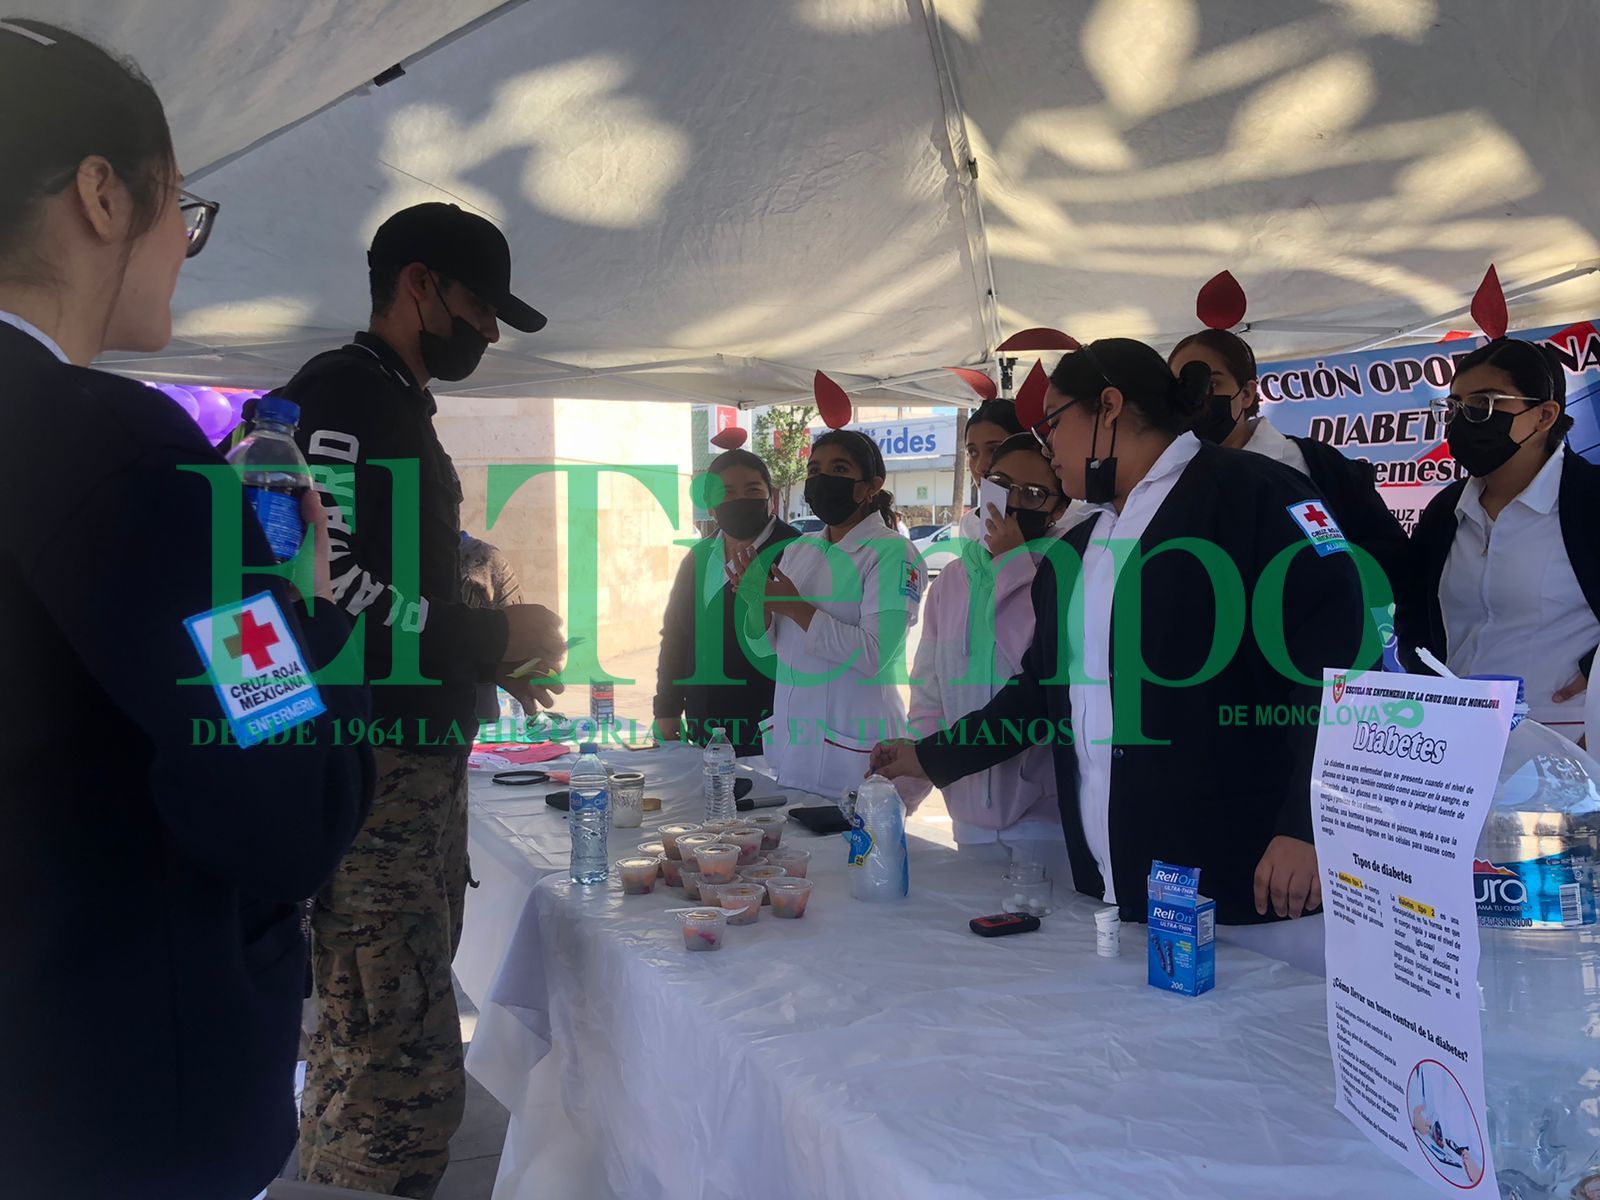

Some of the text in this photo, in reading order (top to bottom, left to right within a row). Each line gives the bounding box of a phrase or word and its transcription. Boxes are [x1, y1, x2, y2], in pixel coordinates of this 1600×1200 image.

[230, 661, 302, 698] CRUZ ROJA
[239, 675, 306, 711] MEXICANA
[1346, 686, 1365, 694] ESCUELA
[1366, 688, 1372, 696] DE
[1406, 691, 1415, 700] DE
[1416, 692, 1424, 701] LA
[1425, 694, 1442, 703] CRUZ
[1458, 697, 1468, 706] DE
[1468, 698, 1499, 709] MONCLOVA
[1353, 720, 1447, 764] Diabetes
[1396, 786, 1410, 794] como
[1425, 779, 1443, 788] cuando
[1445, 782, 1451, 790] el
[1451, 784, 1465, 792] nivel
[1466, 786, 1474, 794] de
[1156, 870, 1196, 887] ReliOn
[1353, 853, 1371, 869] Tipos
[1372, 860, 1380, 872] de
[1382, 863, 1412, 884] diabetes
[1164, 885, 1194, 895] ULTRA-THIN
[1475, 879, 1528, 904] ura
[1153, 907, 1193, 923] ReliOn
[1160, 921, 1192, 932] ULTRA-THIN
[1171, 981, 1184, 990] 200
[1367, 998, 1375, 1009] un
[1375, 1001, 1392, 1018] buen
[1393, 1012, 1417, 1033] control
[1418, 1025, 1426, 1038] de
[1427, 1029, 1434, 1043] la
[1435, 1035, 1468, 1062] diabetes?
